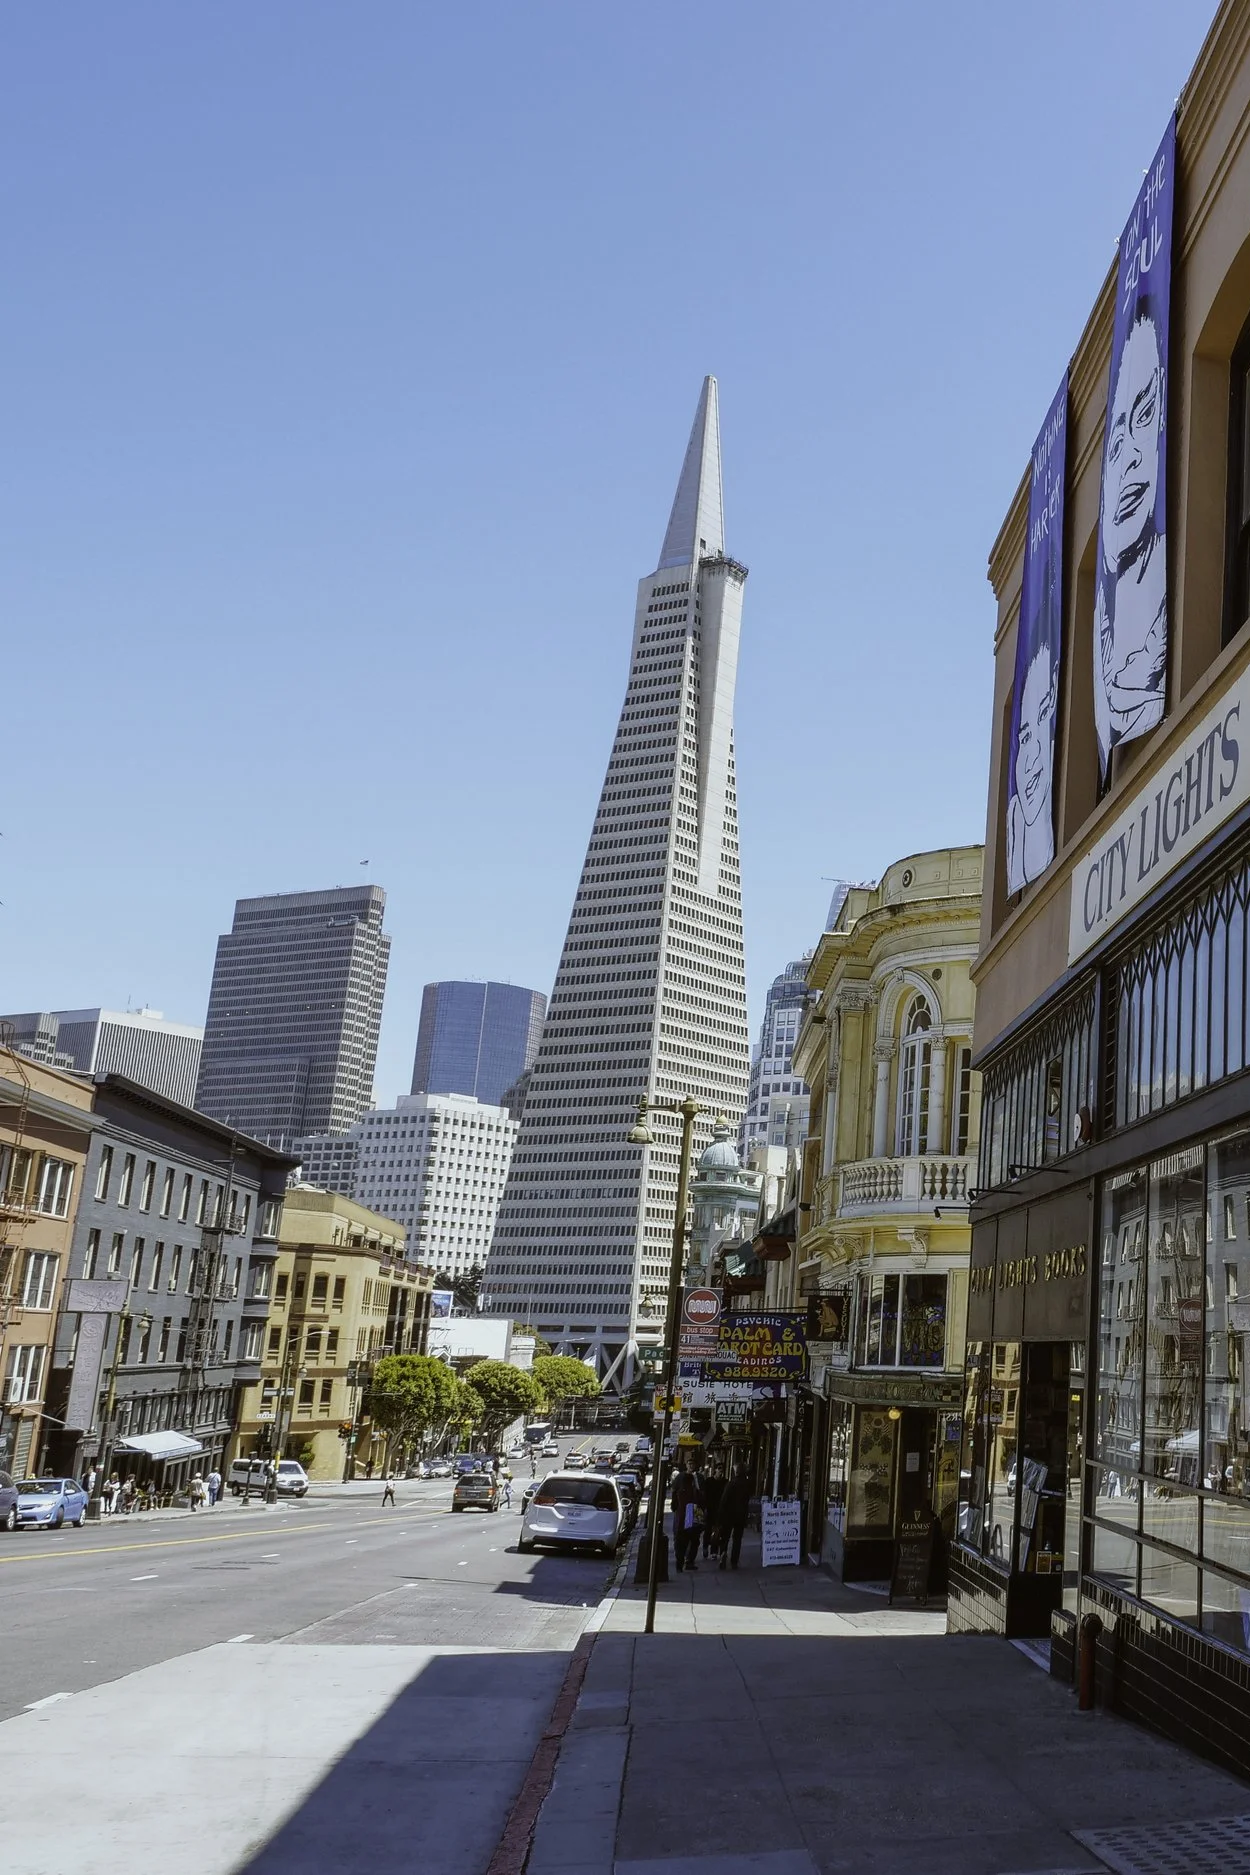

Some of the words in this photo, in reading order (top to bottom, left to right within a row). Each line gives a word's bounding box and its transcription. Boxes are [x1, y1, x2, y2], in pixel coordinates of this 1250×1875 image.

[1123, 215, 1163, 314] SOUL
[1031, 474, 1061, 556] HARER
[1083, 833, 1135, 932] CITY
[1137, 702, 1240, 880] LIGHTS
[999, 1256, 1037, 1289] LIGHTS
[1045, 1244, 1085, 1280] BOOKS
[700, 1327, 713, 1335] stop
[720, 1327, 771, 1341] PALM
[782, 1328, 795, 1340] &
[681, 1336, 690, 1344] 41
[762, 1342, 803, 1355] CARD
[737, 1356, 782, 1366] EADINGS
[717, 1403, 746, 1415] ATM
[901, 1522, 931, 1530] GUINNESS
